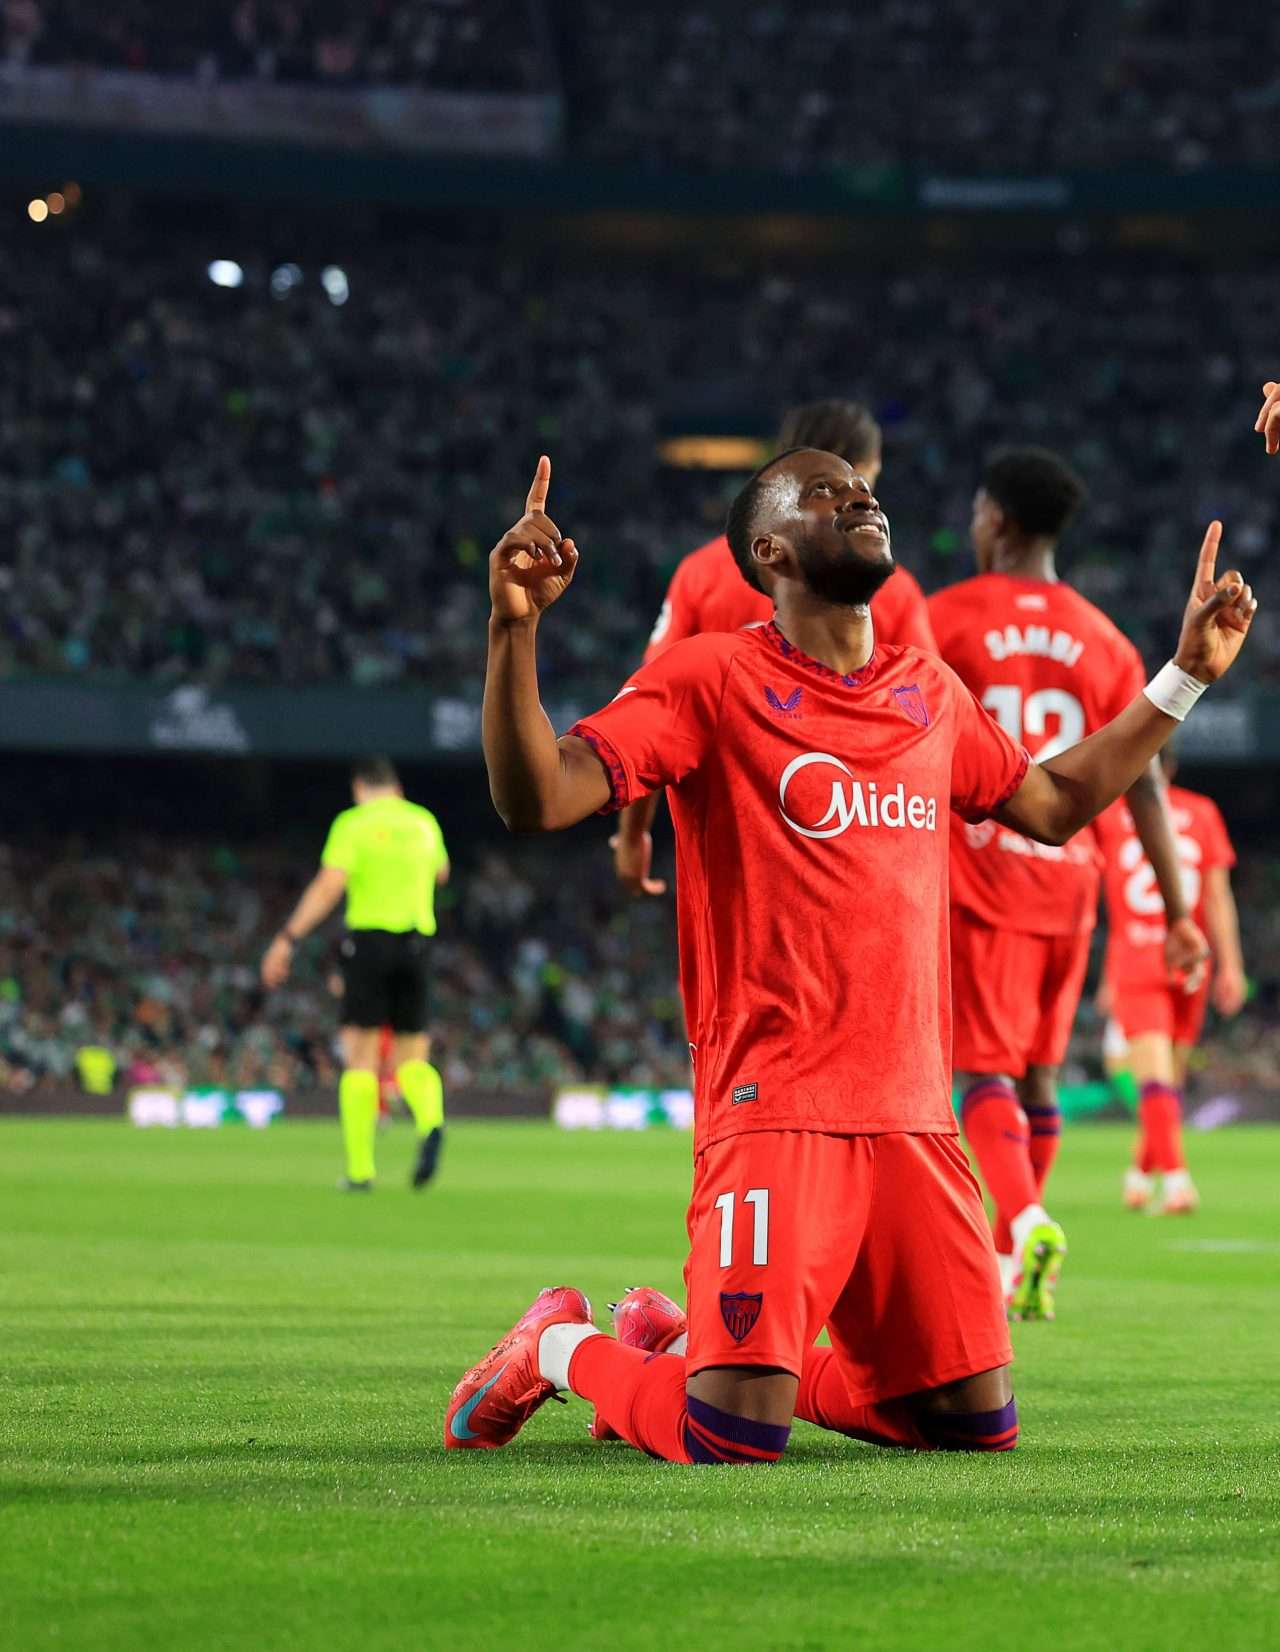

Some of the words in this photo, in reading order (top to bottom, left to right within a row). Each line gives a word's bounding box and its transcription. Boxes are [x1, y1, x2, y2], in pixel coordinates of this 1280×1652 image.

[984, 623, 1084, 668] SAMBI
[981, 685, 1085, 765] 12
[778, 781, 937, 839] Midea
[714, 1188, 769, 1268] 11
